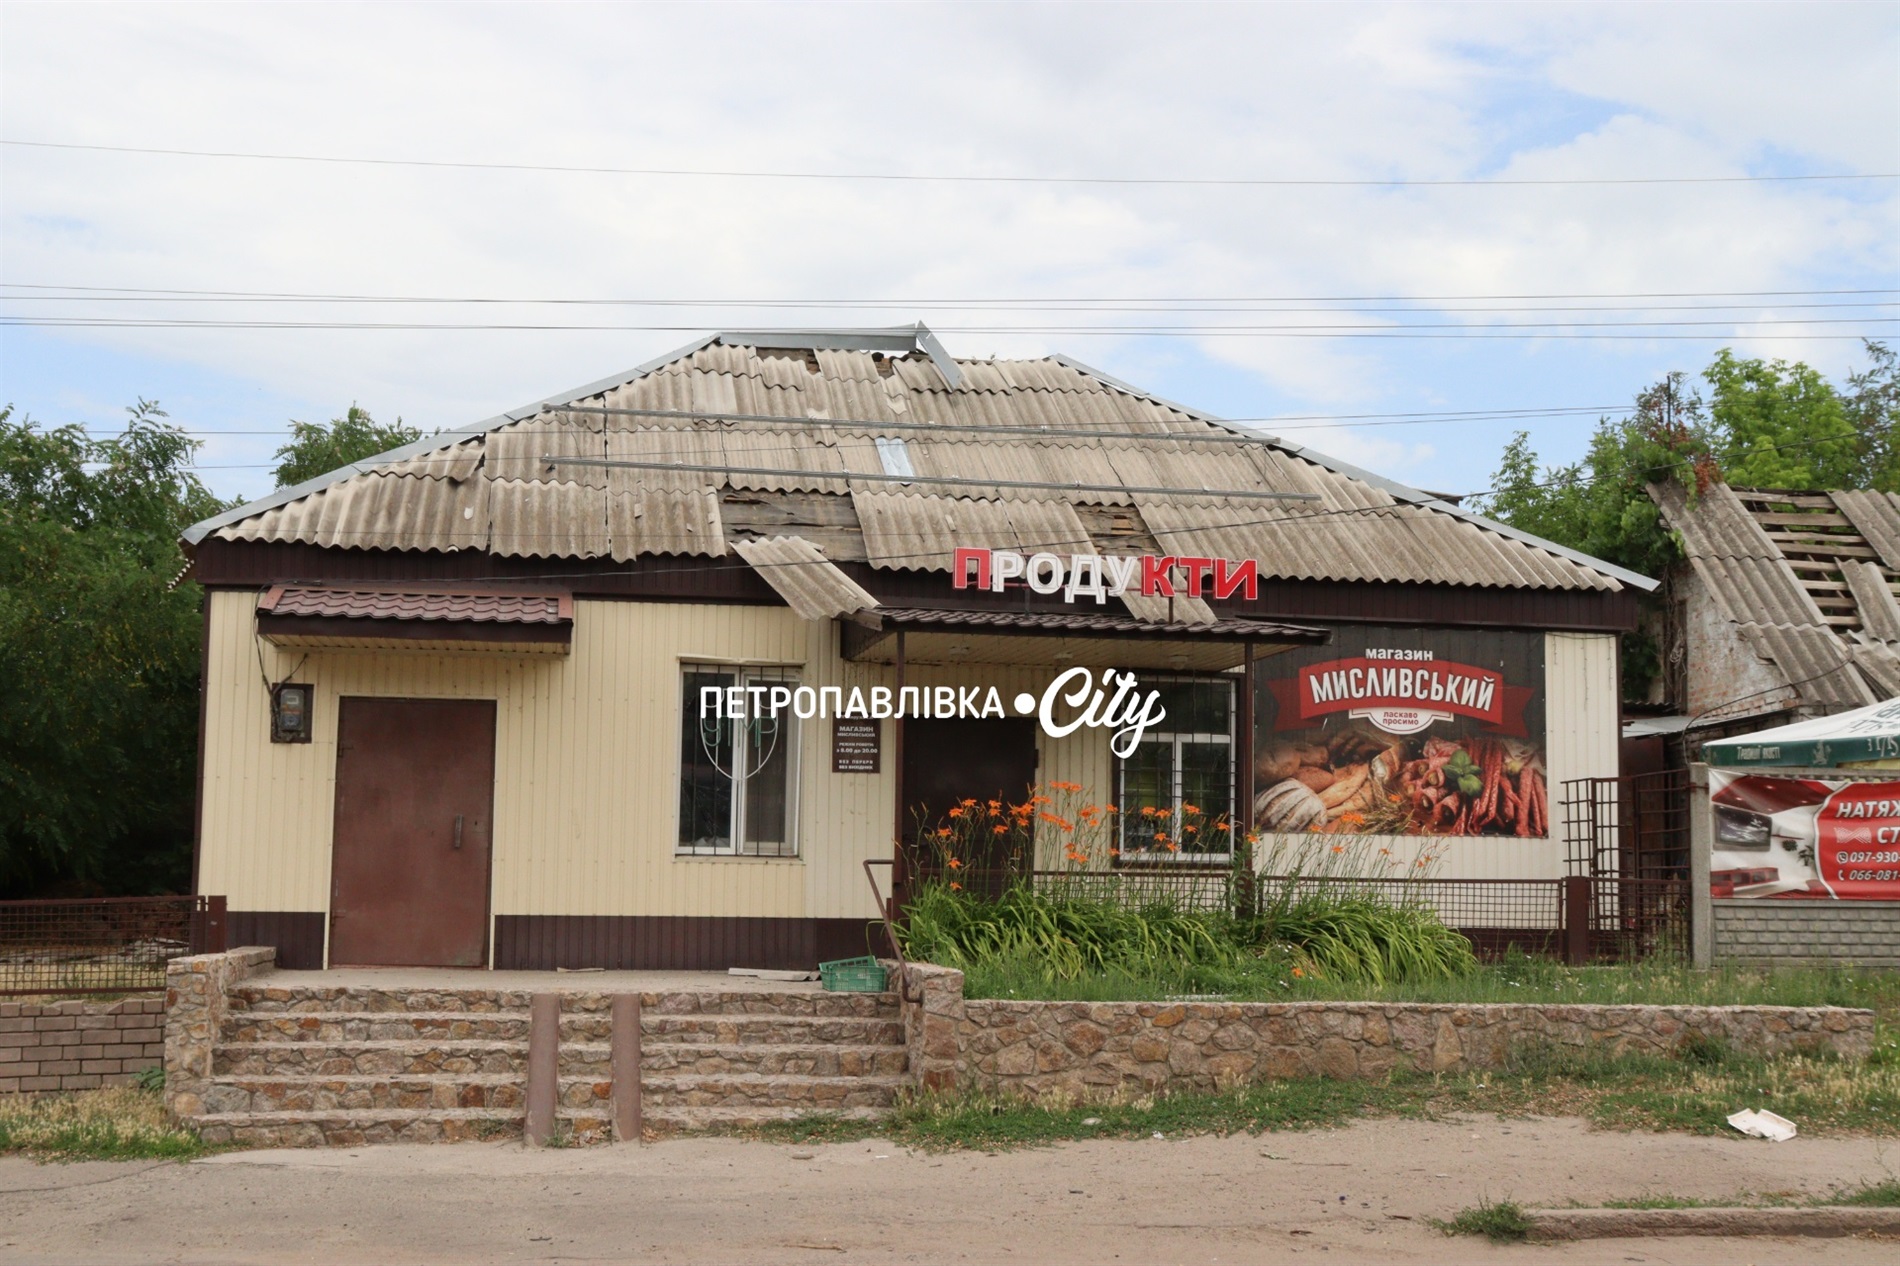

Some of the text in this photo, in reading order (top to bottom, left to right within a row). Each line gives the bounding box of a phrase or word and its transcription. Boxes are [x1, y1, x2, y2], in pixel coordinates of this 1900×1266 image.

[953, 547, 1258, 604] ПРОДУКТИ
[1365, 648, 1433, 661] магазин
[1309, 667, 1495, 711] МИСЛИВСЬКИЙ
[1383, 711, 1418, 719] ласкаво
[1382, 718, 1419, 726] просимо
